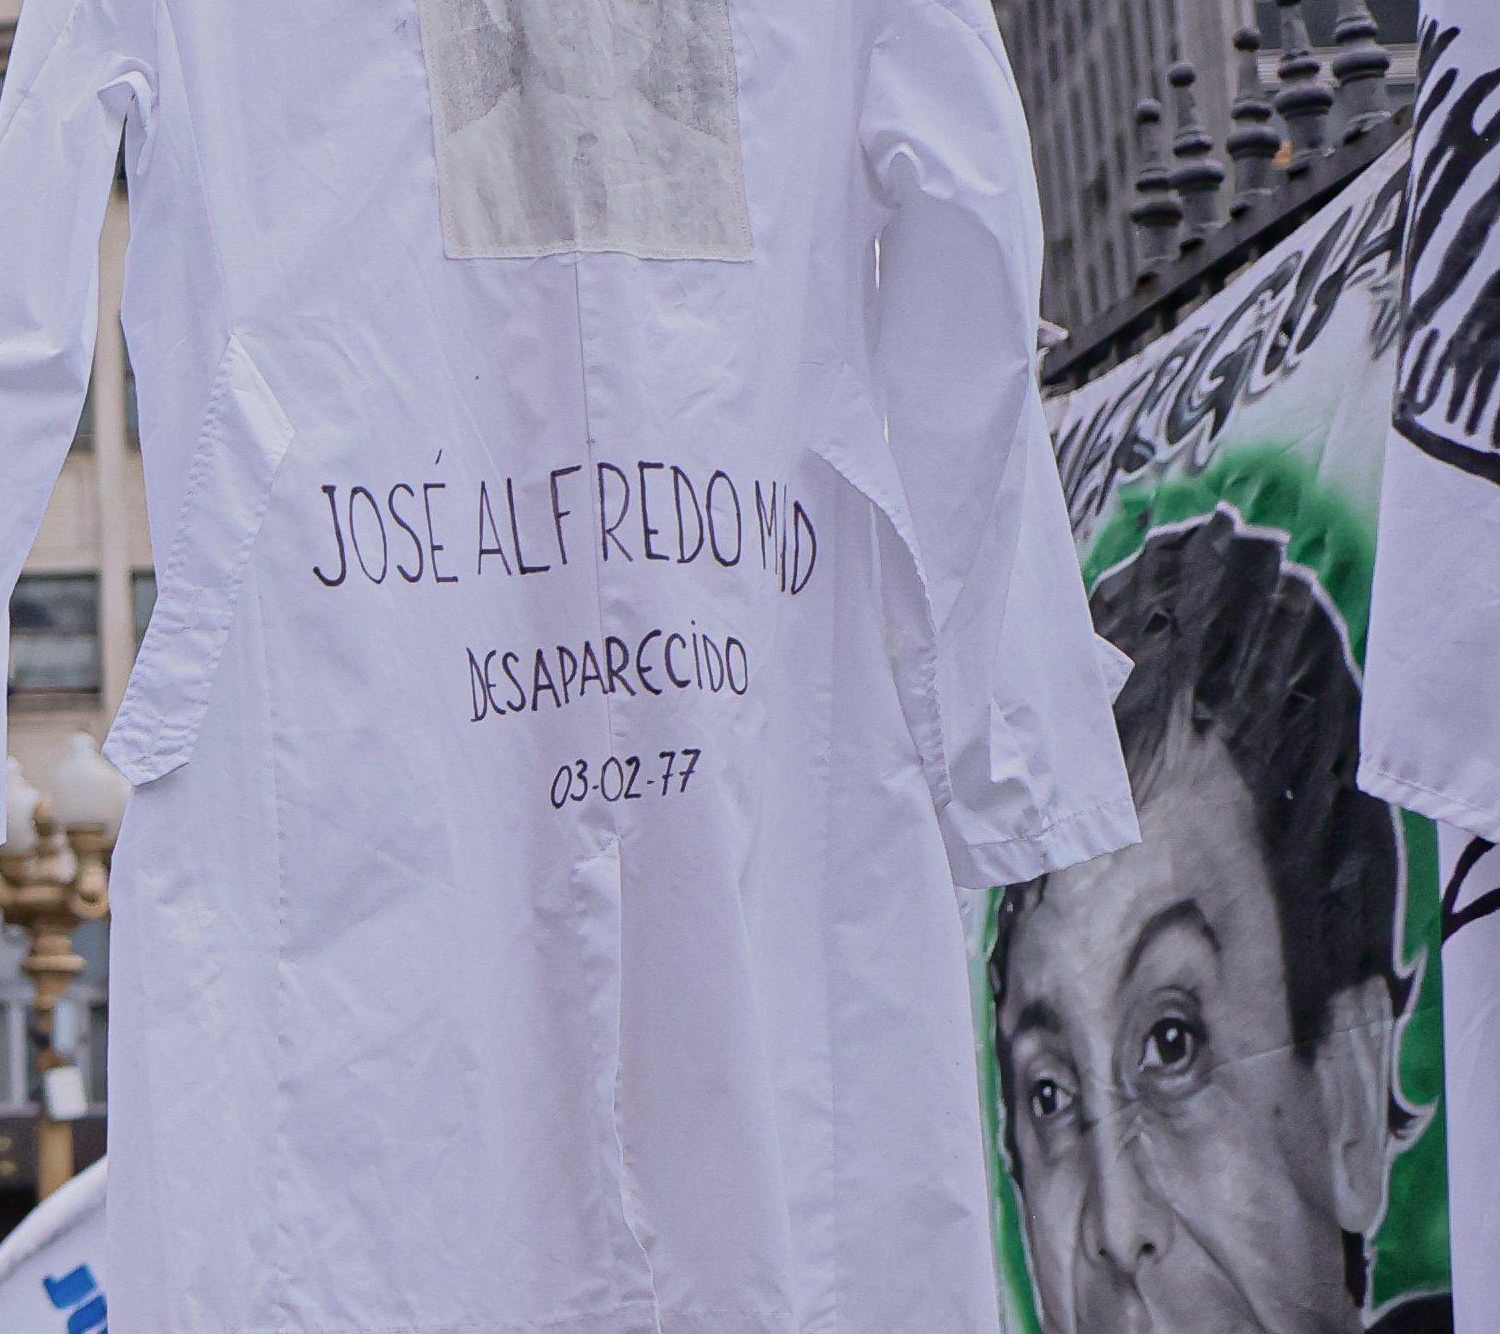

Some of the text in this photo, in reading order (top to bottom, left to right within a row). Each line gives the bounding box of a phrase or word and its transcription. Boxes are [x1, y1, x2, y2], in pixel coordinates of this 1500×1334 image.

[311, 448, 460, 588] JOSÉ
[476, 459, 743, 577] ALFREDO
[465, 627, 749, 724] DESAPARECIDO
[549, 747, 703, 811] 03-02-77
